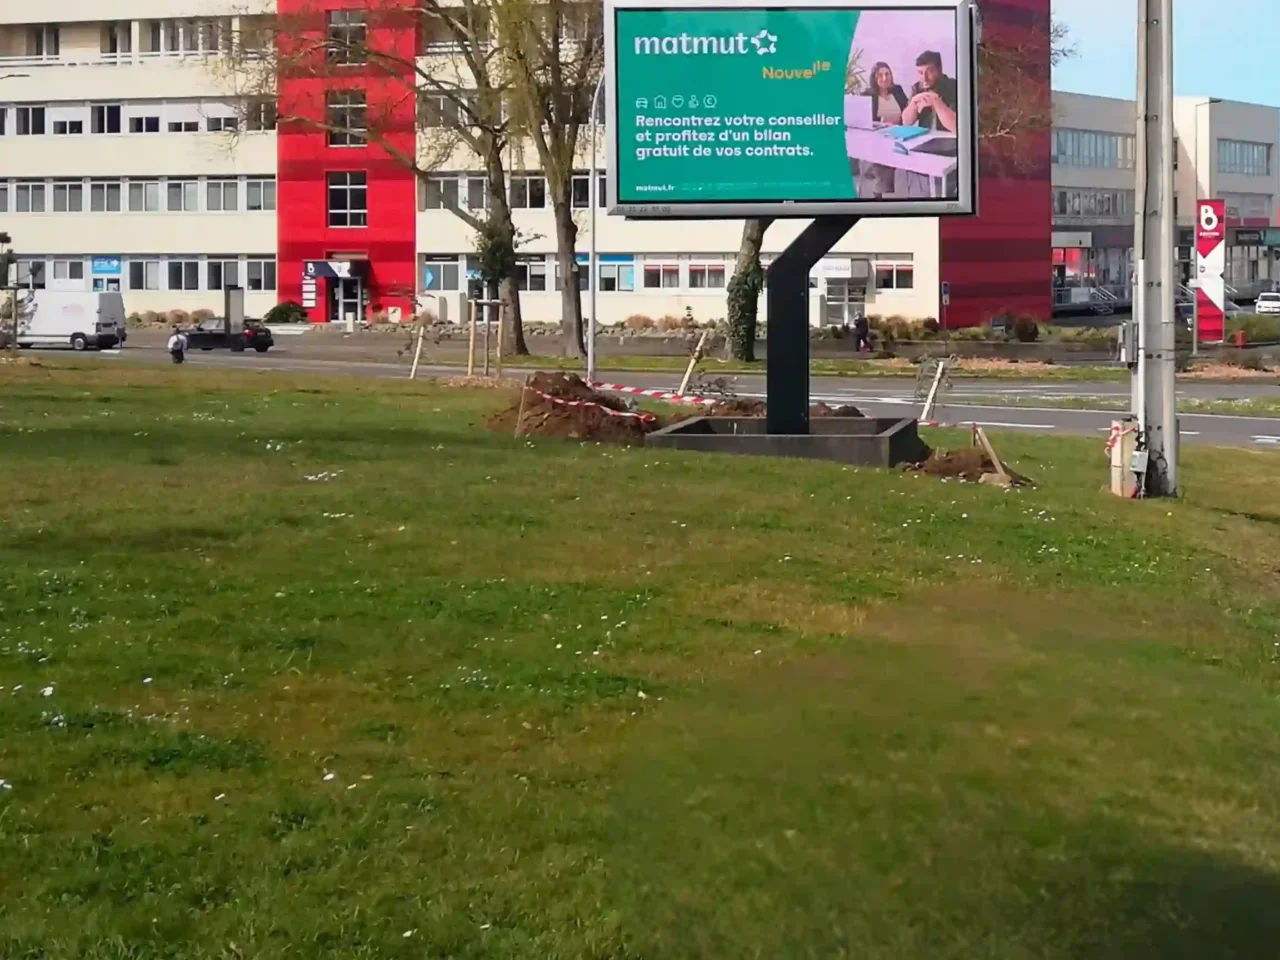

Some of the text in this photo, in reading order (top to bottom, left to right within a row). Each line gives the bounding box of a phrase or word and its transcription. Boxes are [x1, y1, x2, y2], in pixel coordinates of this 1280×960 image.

[634, 32, 749, 55] matmut
[762, 60, 831, 79] Nouvelle
[636, 114, 841, 127] Rencontrez votre conseiller
[636, 130, 791, 144] et profitez d'un bilan
[636, 145, 814, 160] gratuit de vos contrats.
